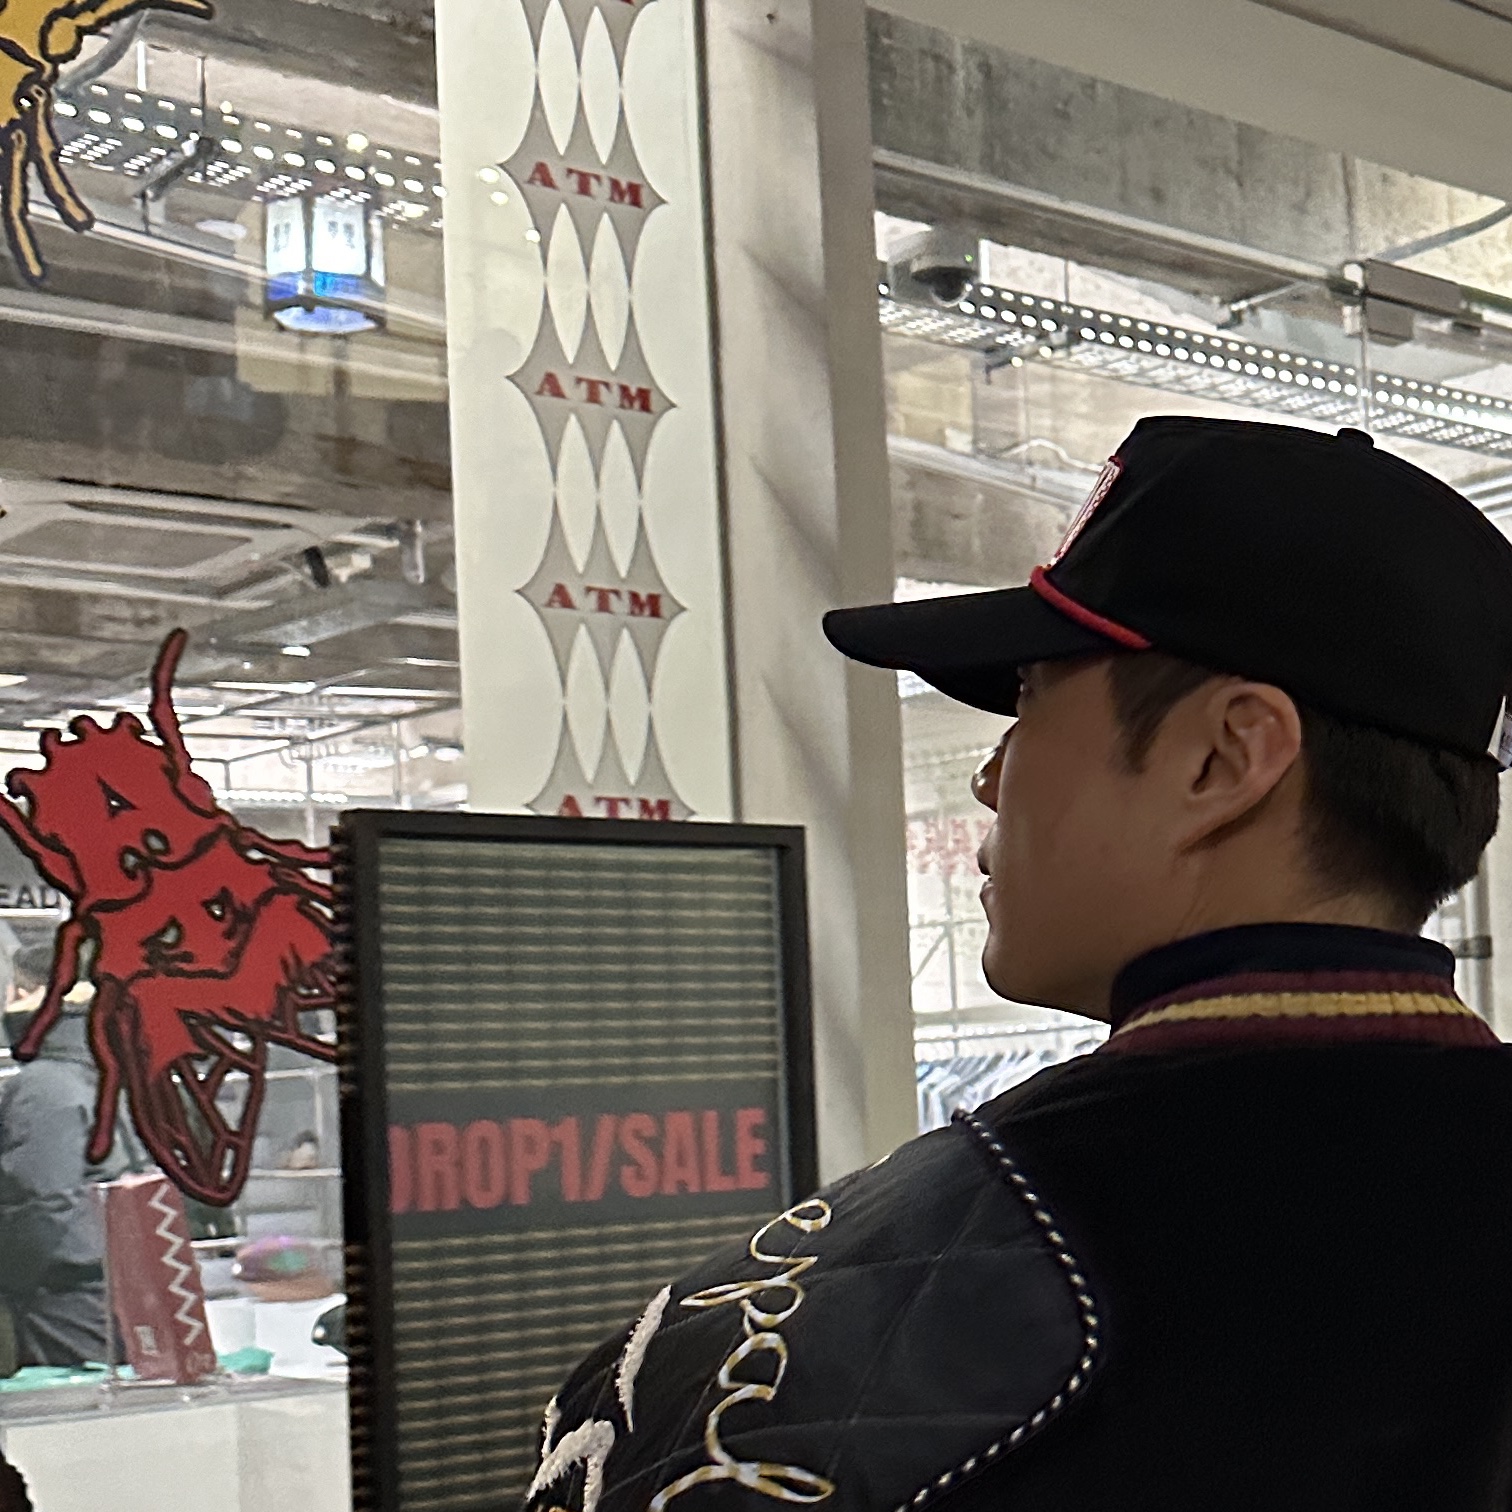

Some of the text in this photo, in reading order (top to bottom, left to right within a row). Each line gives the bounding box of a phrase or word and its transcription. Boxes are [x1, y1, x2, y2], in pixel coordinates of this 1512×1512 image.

[527, 161, 644, 208] ATM
[536, 370, 654, 413] ATM
[545, 582, 663, 619] ATM
[557, 794, 671, 821] ATM
